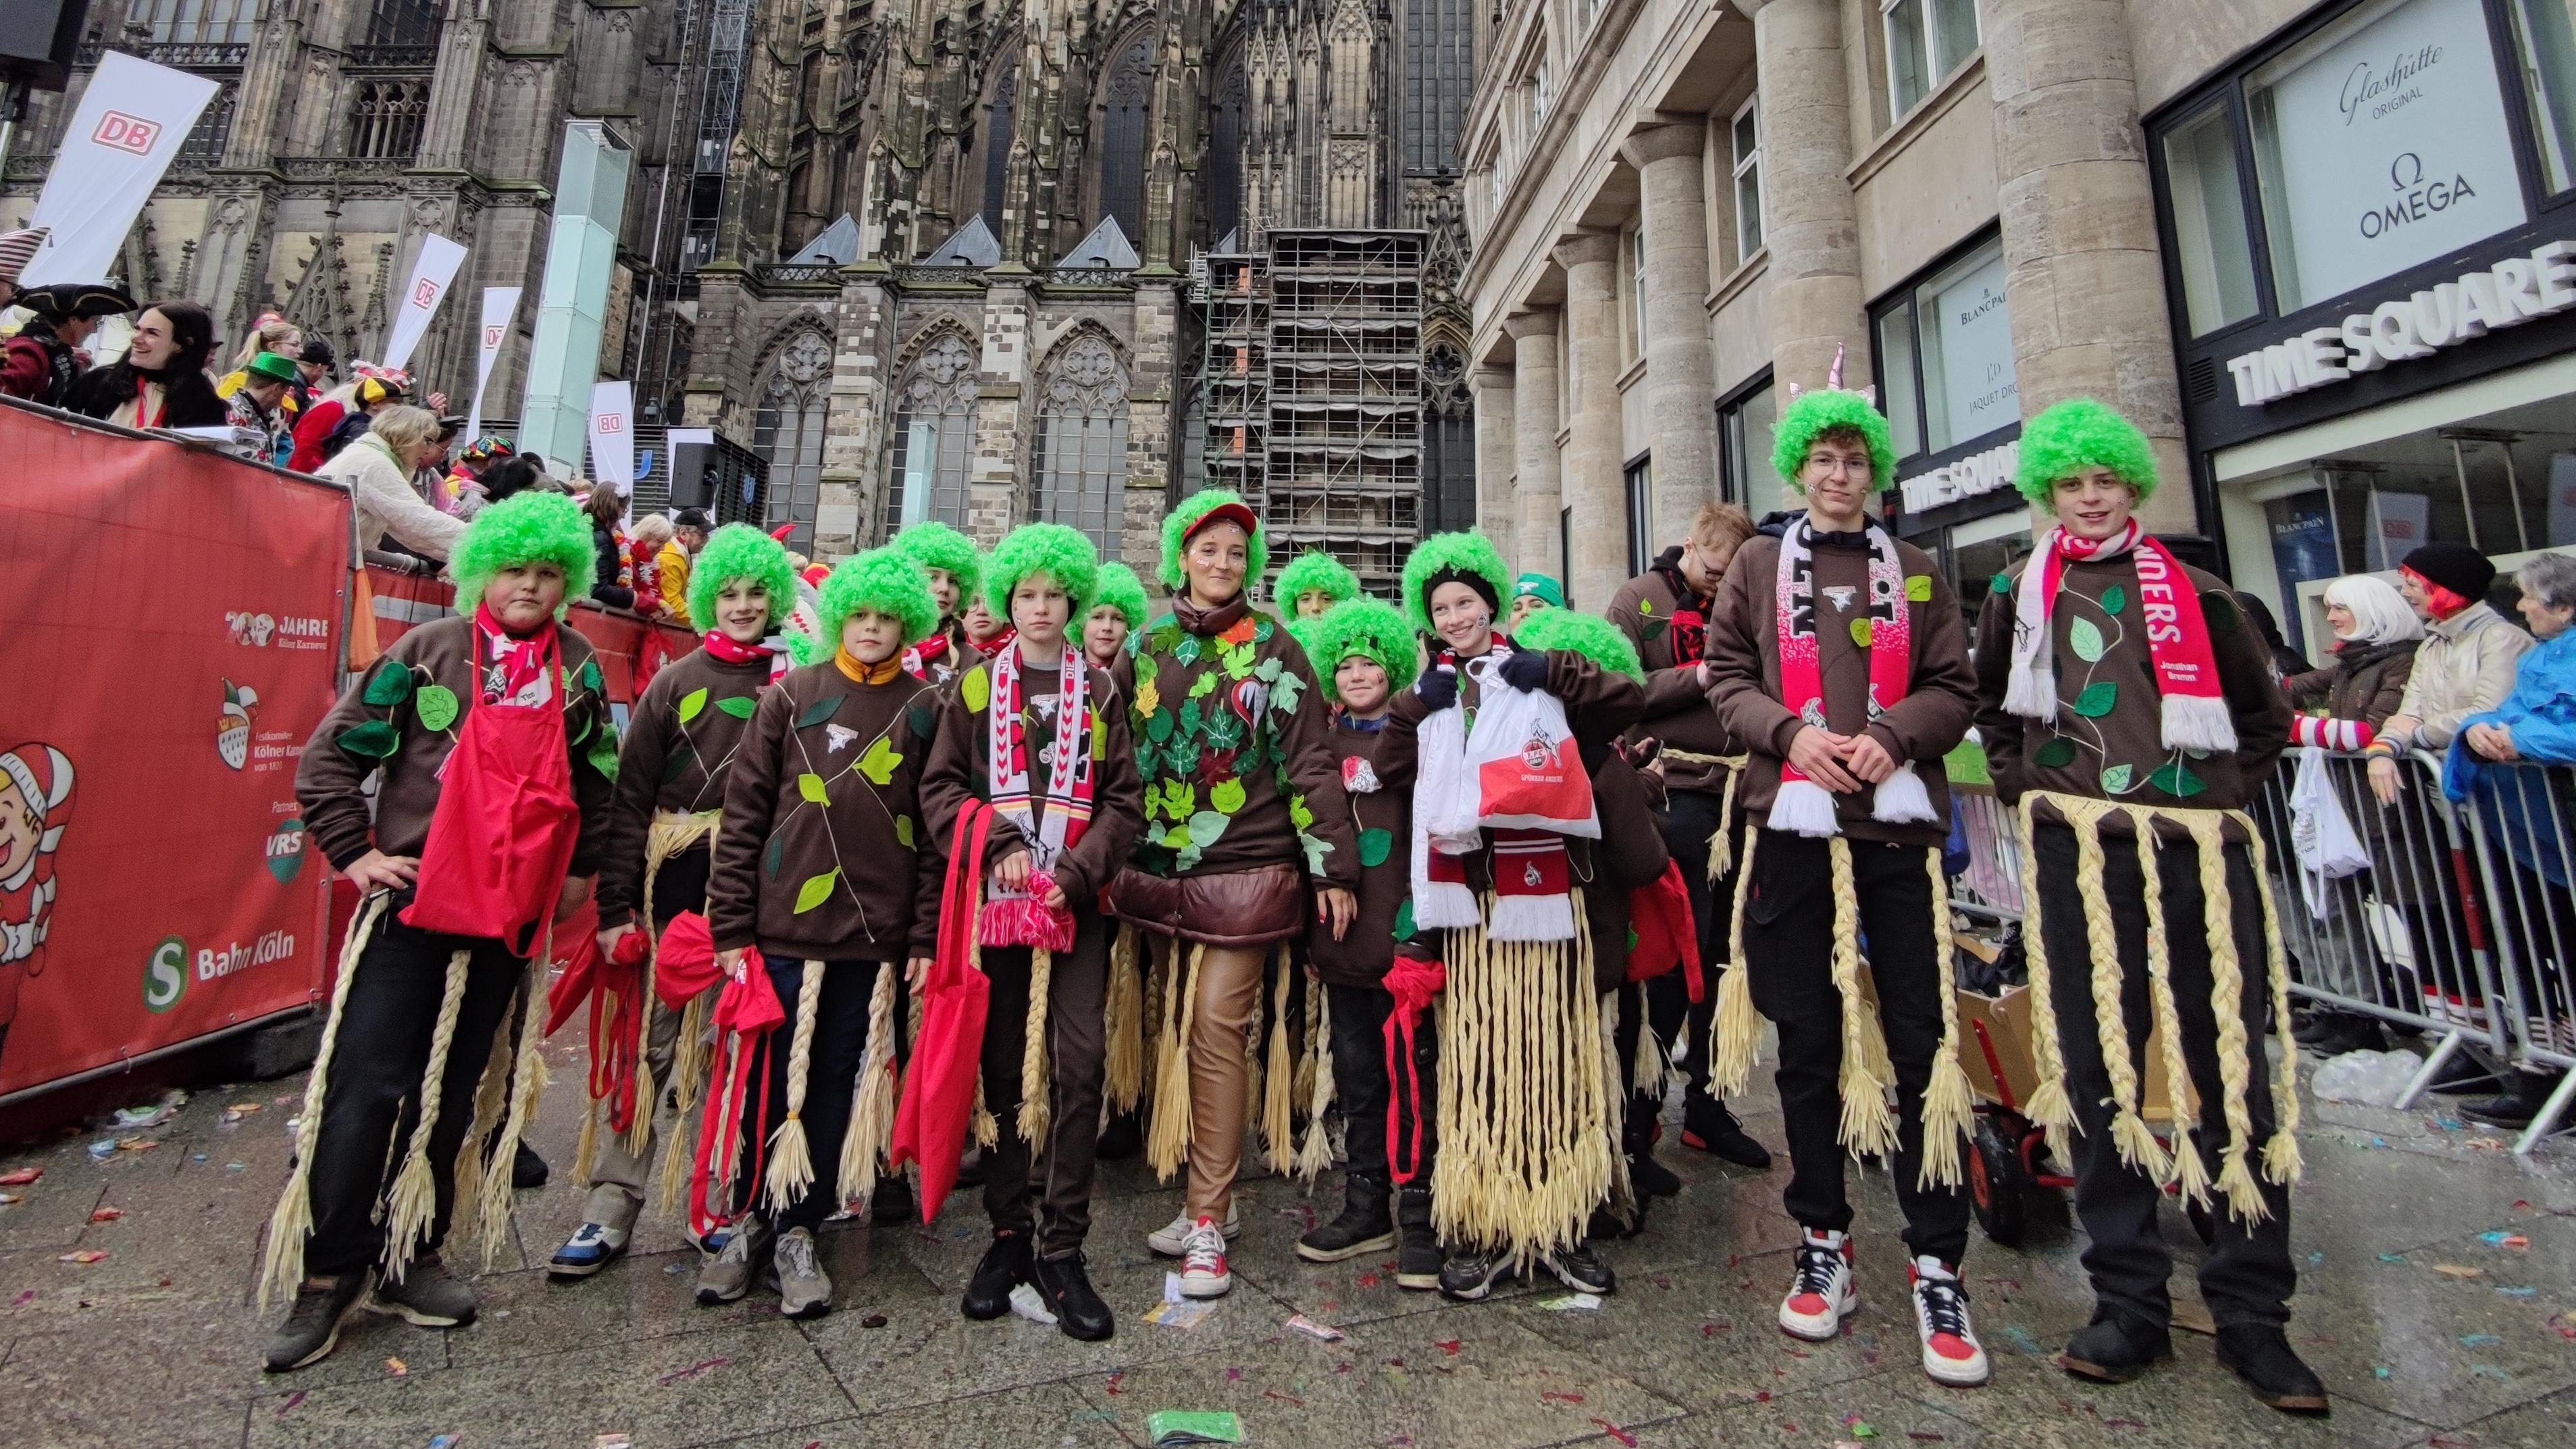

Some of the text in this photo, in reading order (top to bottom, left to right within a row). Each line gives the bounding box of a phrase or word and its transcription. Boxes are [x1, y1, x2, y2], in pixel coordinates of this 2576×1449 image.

[2340, 45, 2443, 126] Glashütte
[2372, 86, 2423, 120] ORIGINAL
[100, 116, 151, 147] DB
[2361, 173, 2476, 238] OMEGA
[415, 282, 435, 305] DB
[1961, 291, 2007, 326] BLANCPAI
[1969, 389, 1999, 416] JAQUET
[2132, 544, 2182, 652] NDERS.
[224, 611, 328, 646] 200 JAHRE
[1065, 659, 1075, 680] DIE
[254, 744, 285, 758] Kölner
[266, 831, 303, 857] VRS
[148, 929, 294, 1006] S Bahn Köln
